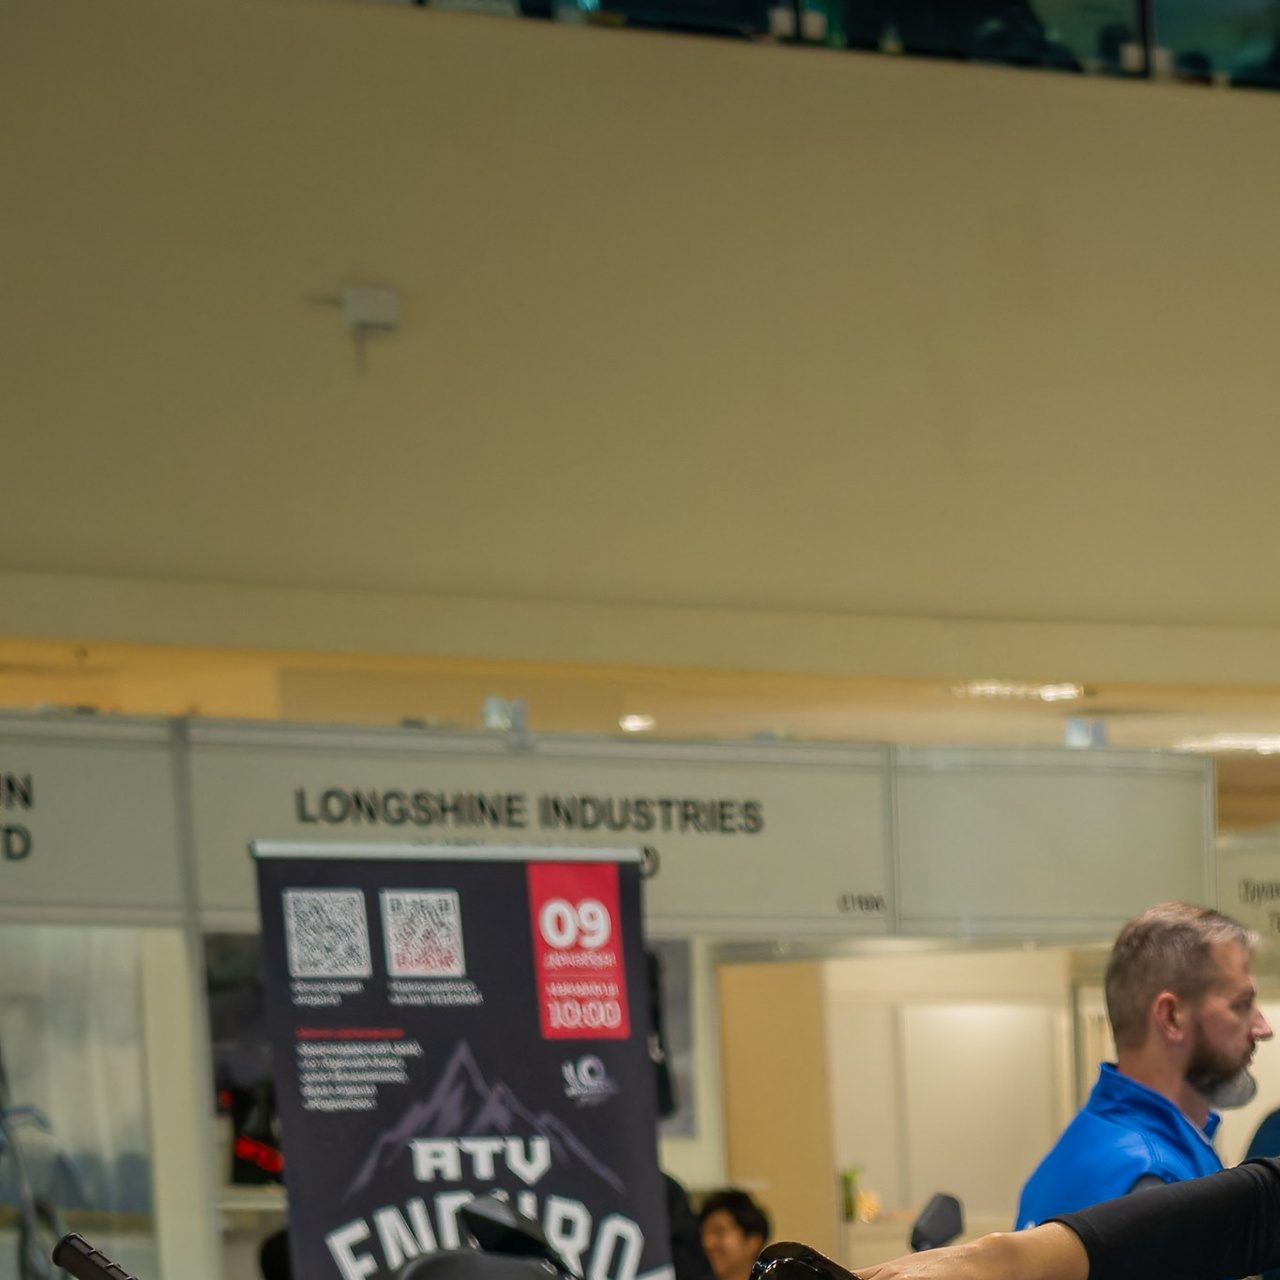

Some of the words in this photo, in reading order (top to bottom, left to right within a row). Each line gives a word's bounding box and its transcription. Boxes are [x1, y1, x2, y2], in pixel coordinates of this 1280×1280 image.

[295, 789, 526, 829] LONGSHINE
[539, 796, 764, 834] INDUSTRIES
[540, 899, 612, 949] 09
[410, 1136, 551, 1186] ATV
